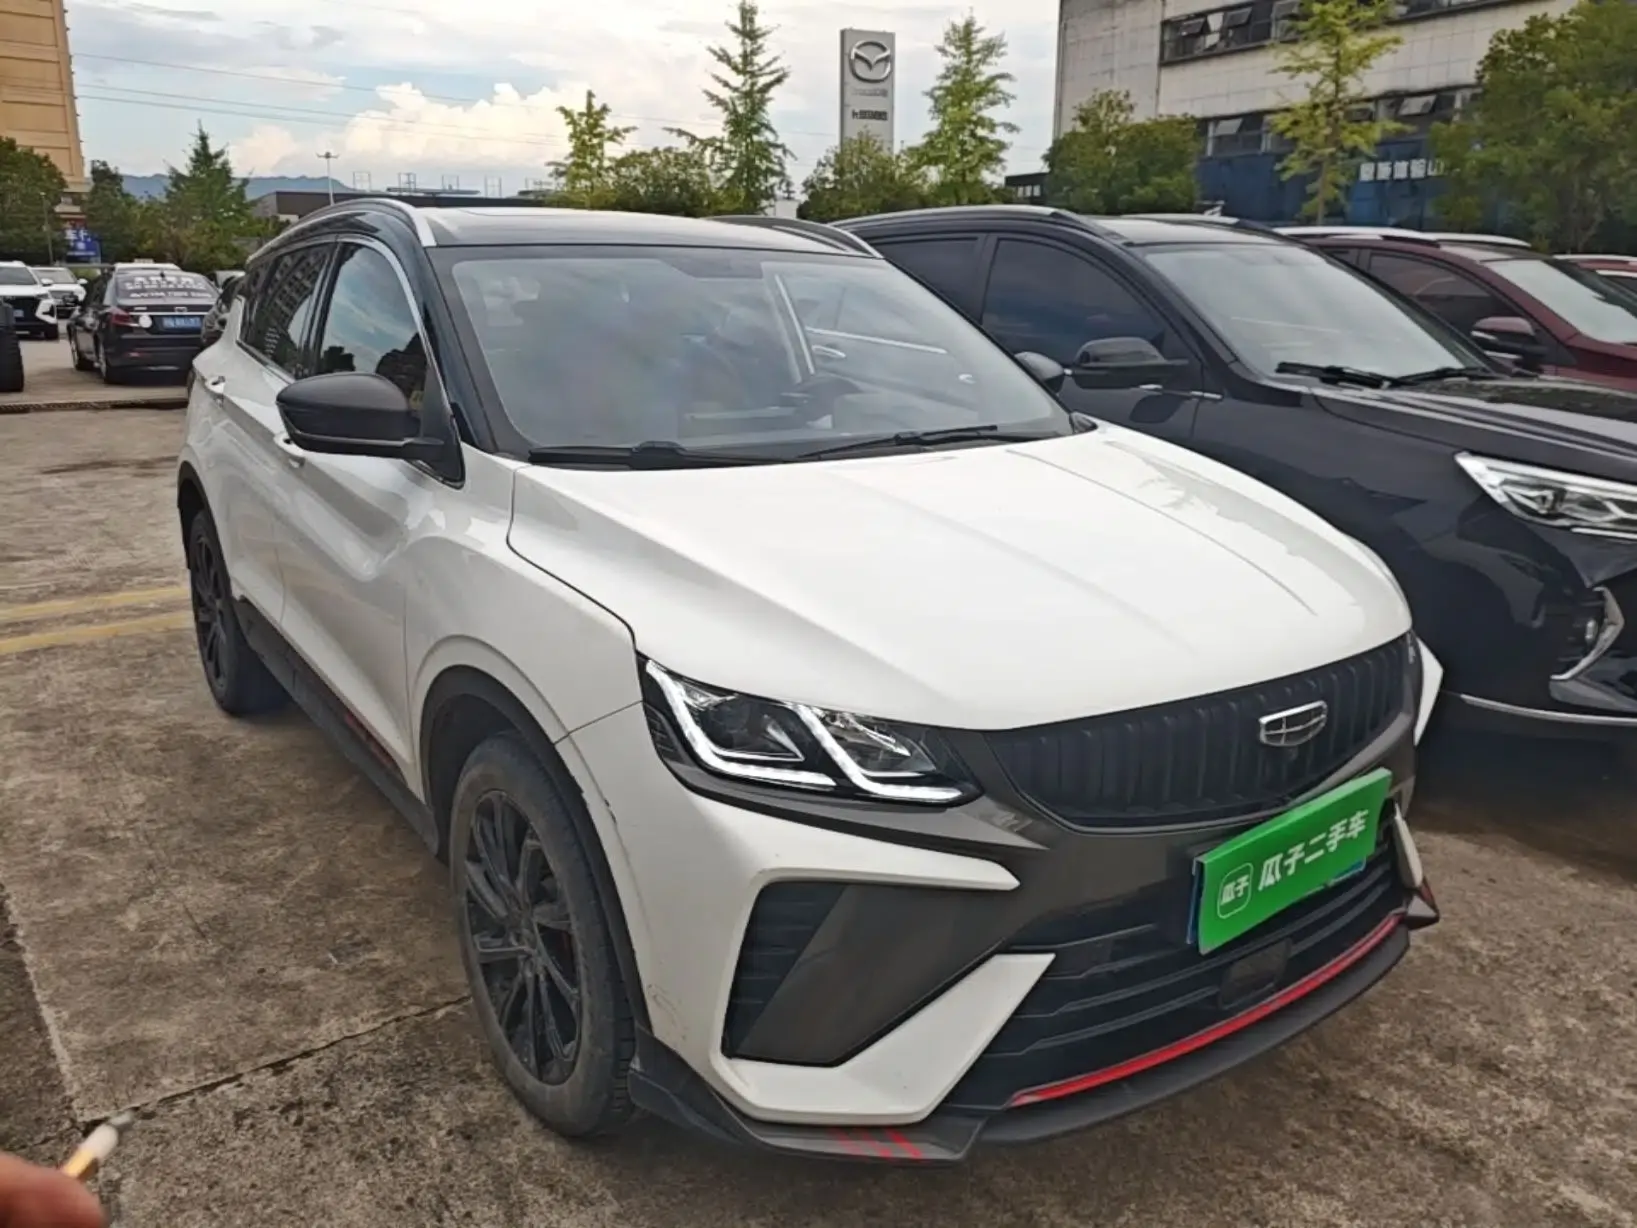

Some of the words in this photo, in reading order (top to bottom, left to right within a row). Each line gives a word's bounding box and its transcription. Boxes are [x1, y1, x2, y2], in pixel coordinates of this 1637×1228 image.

[1257, 809, 1369, 892] 瓜子二手车
[1219, 874, 1250, 907] 瓜子
